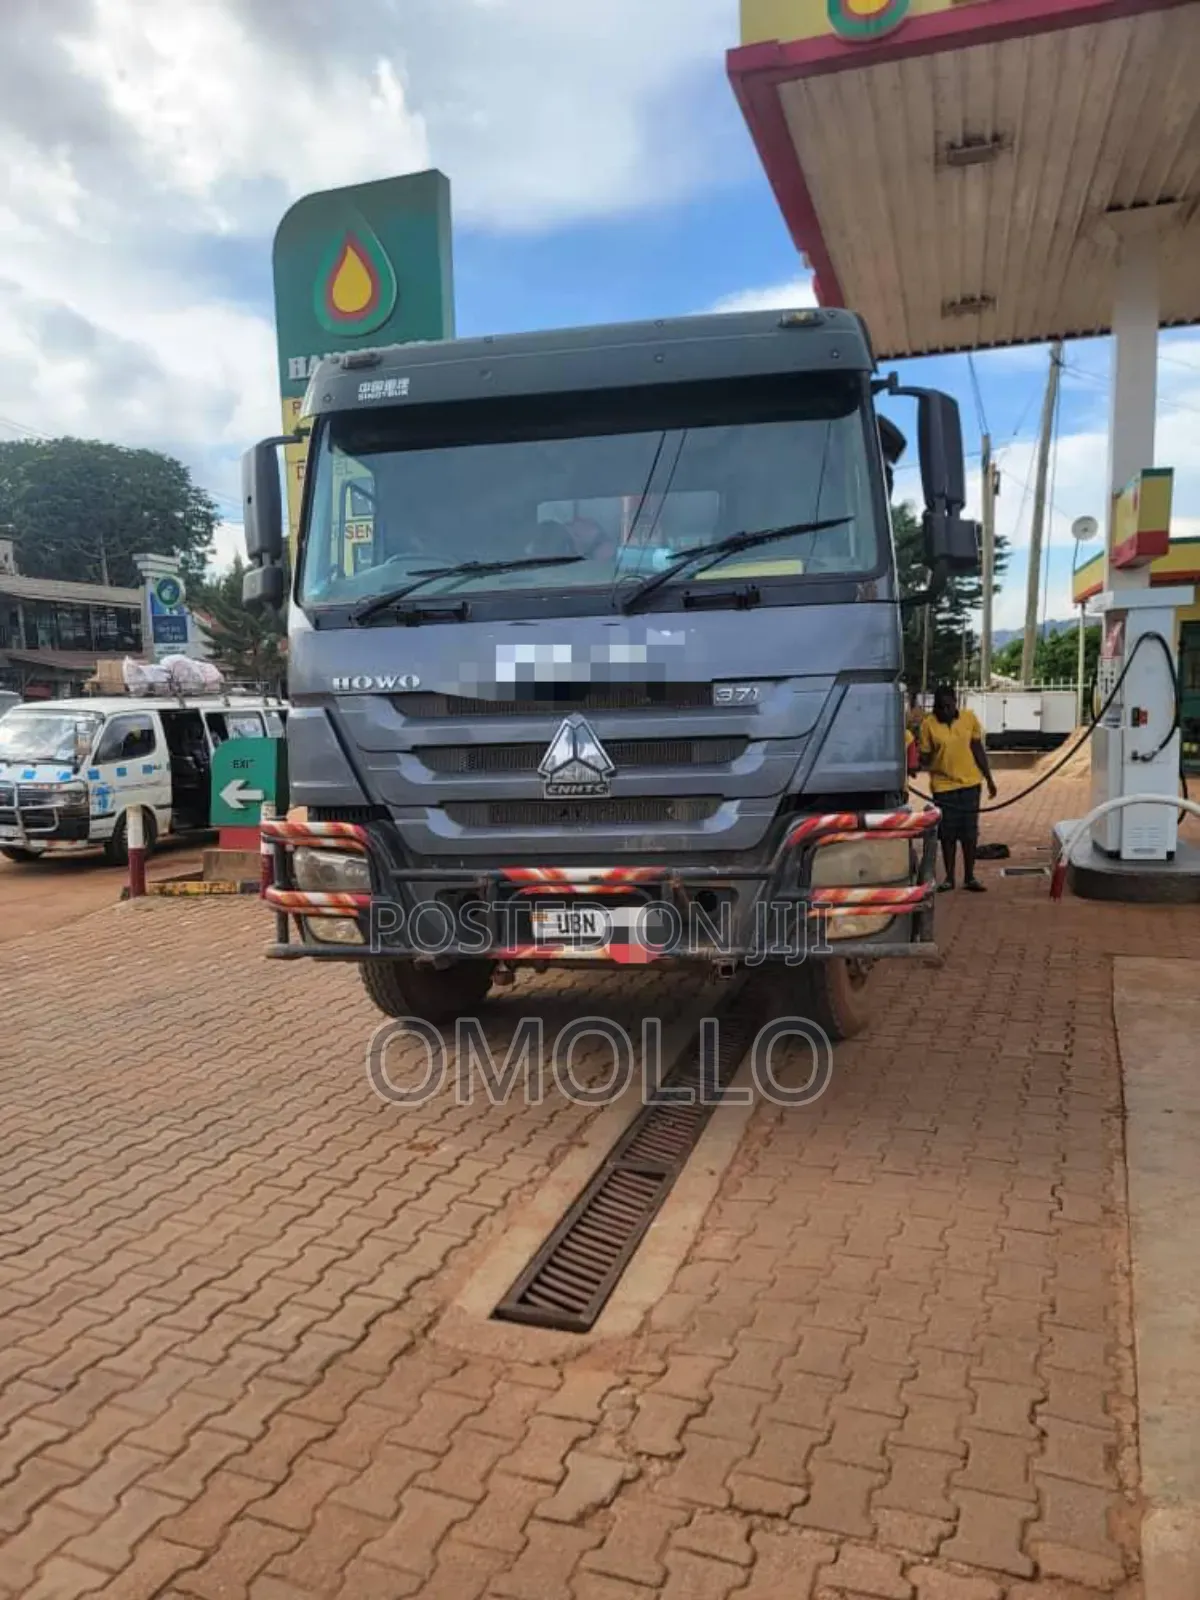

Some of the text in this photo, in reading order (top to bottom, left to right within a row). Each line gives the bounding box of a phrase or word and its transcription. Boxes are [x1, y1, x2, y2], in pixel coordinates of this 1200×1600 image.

[332, 674, 420, 691] HOWO
[716, 687, 759, 701] 371
[233, 758, 256, 769] EXIT
[557, 913, 597, 934] UBN
